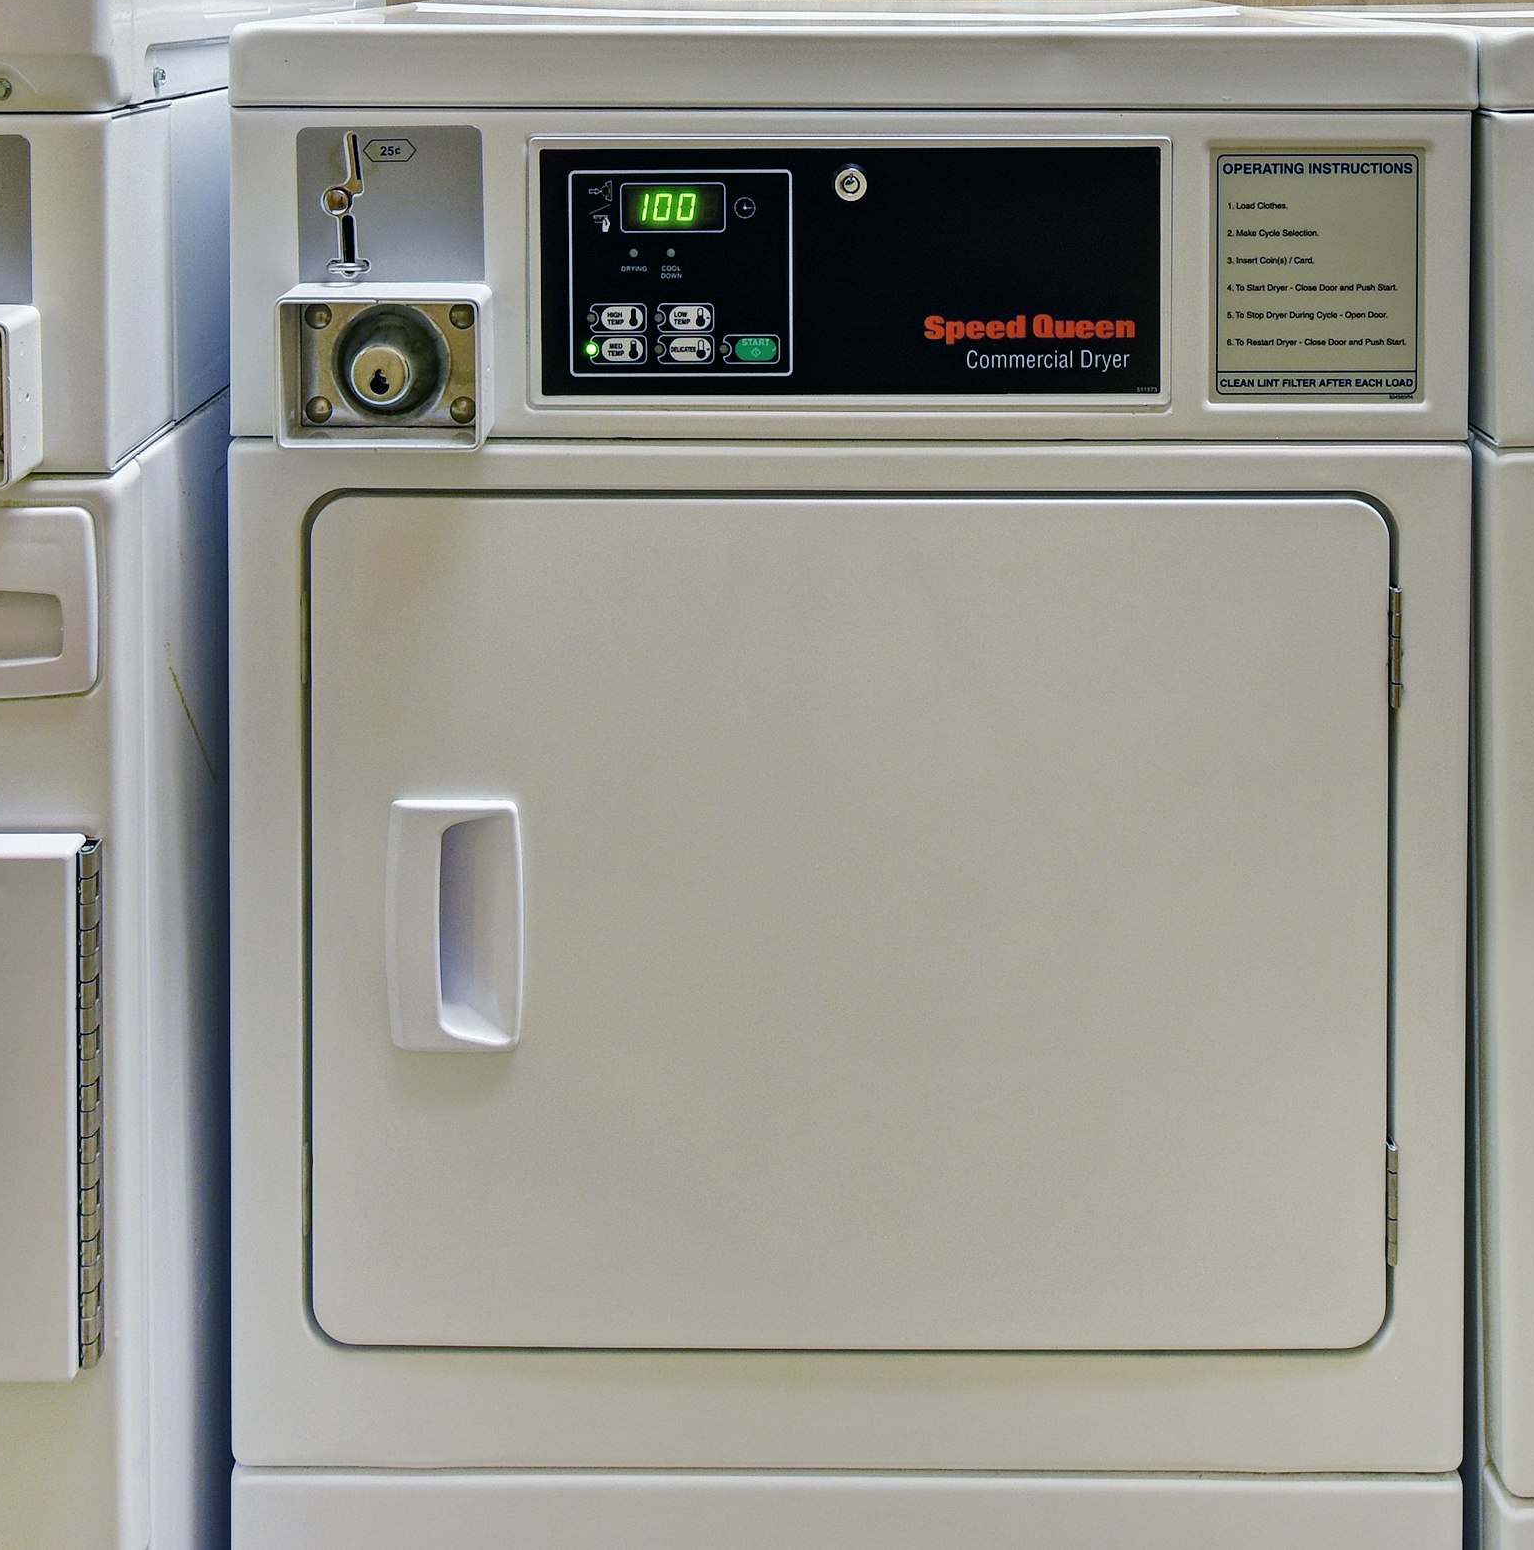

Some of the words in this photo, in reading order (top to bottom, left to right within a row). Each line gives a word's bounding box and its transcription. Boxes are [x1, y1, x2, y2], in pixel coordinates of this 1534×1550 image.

[1222, 161, 1304, 175] OPERATING
[1308, 161, 1414, 174] INSTRUCTIONS
[642, 193, 697, 222] 100
[1227, 201, 1234, 210] 1.
[1256, 201, 1288, 210] Clothes.
[924, 314, 1026, 345] Speed
[1033, 314, 1136, 340] Queen
[966, 350, 1073, 369] Commercial
[1081, 351, 1130, 373] Dryer
[1219, 378, 1254, 387] CLEAN
[1256, 377, 1280, 387] LINT
[1281, 377, 1316, 387] FILTER
[1317, 378, 1352, 387] AFTER
[1354, 378, 1383, 387] EACH
[1384, 377, 1413, 387] LOAD
